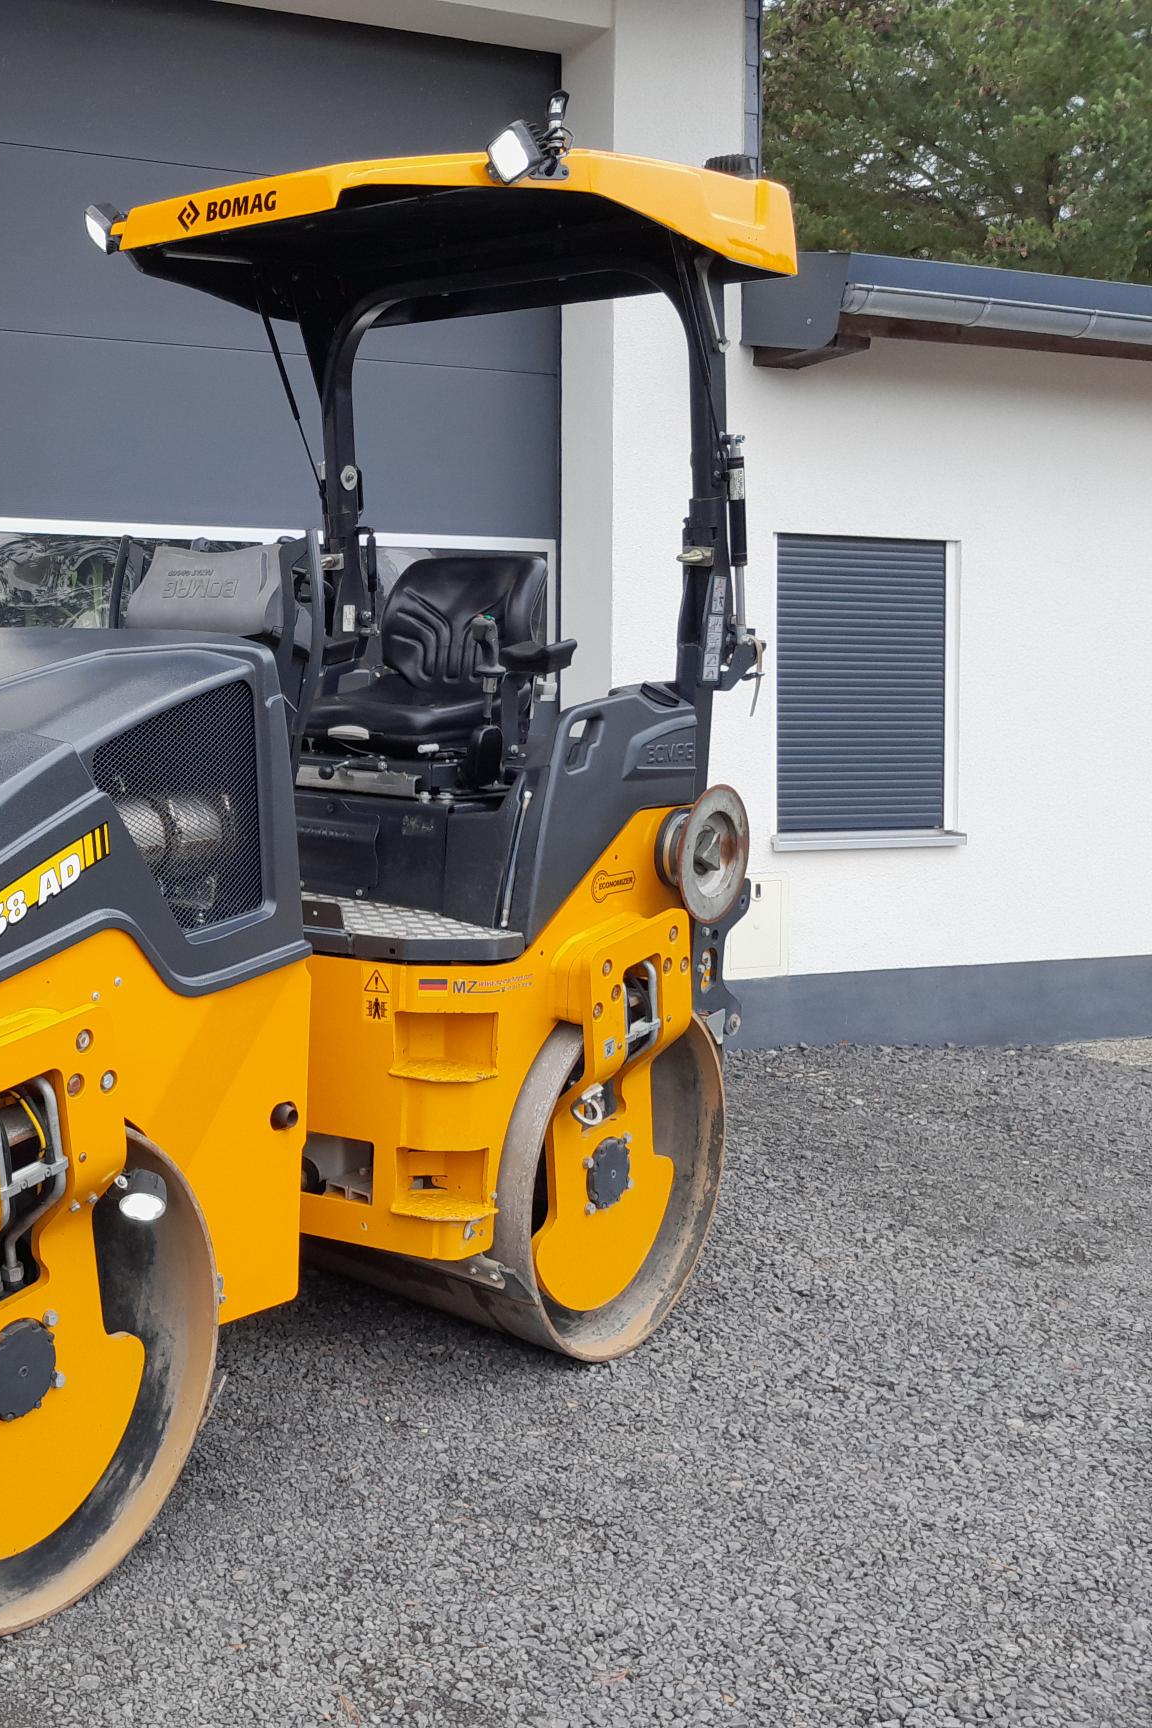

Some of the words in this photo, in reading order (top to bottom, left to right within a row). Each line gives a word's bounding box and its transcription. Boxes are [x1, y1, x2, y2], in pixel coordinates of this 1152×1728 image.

[206, 190, 277, 222] BOMAG
[162, 579, 239, 599] BOMAG
[37, 852, 82, 907] AD
[598, 876, 633, 890] ECONOMIZER
[452, 979, 478, 994] MZ
